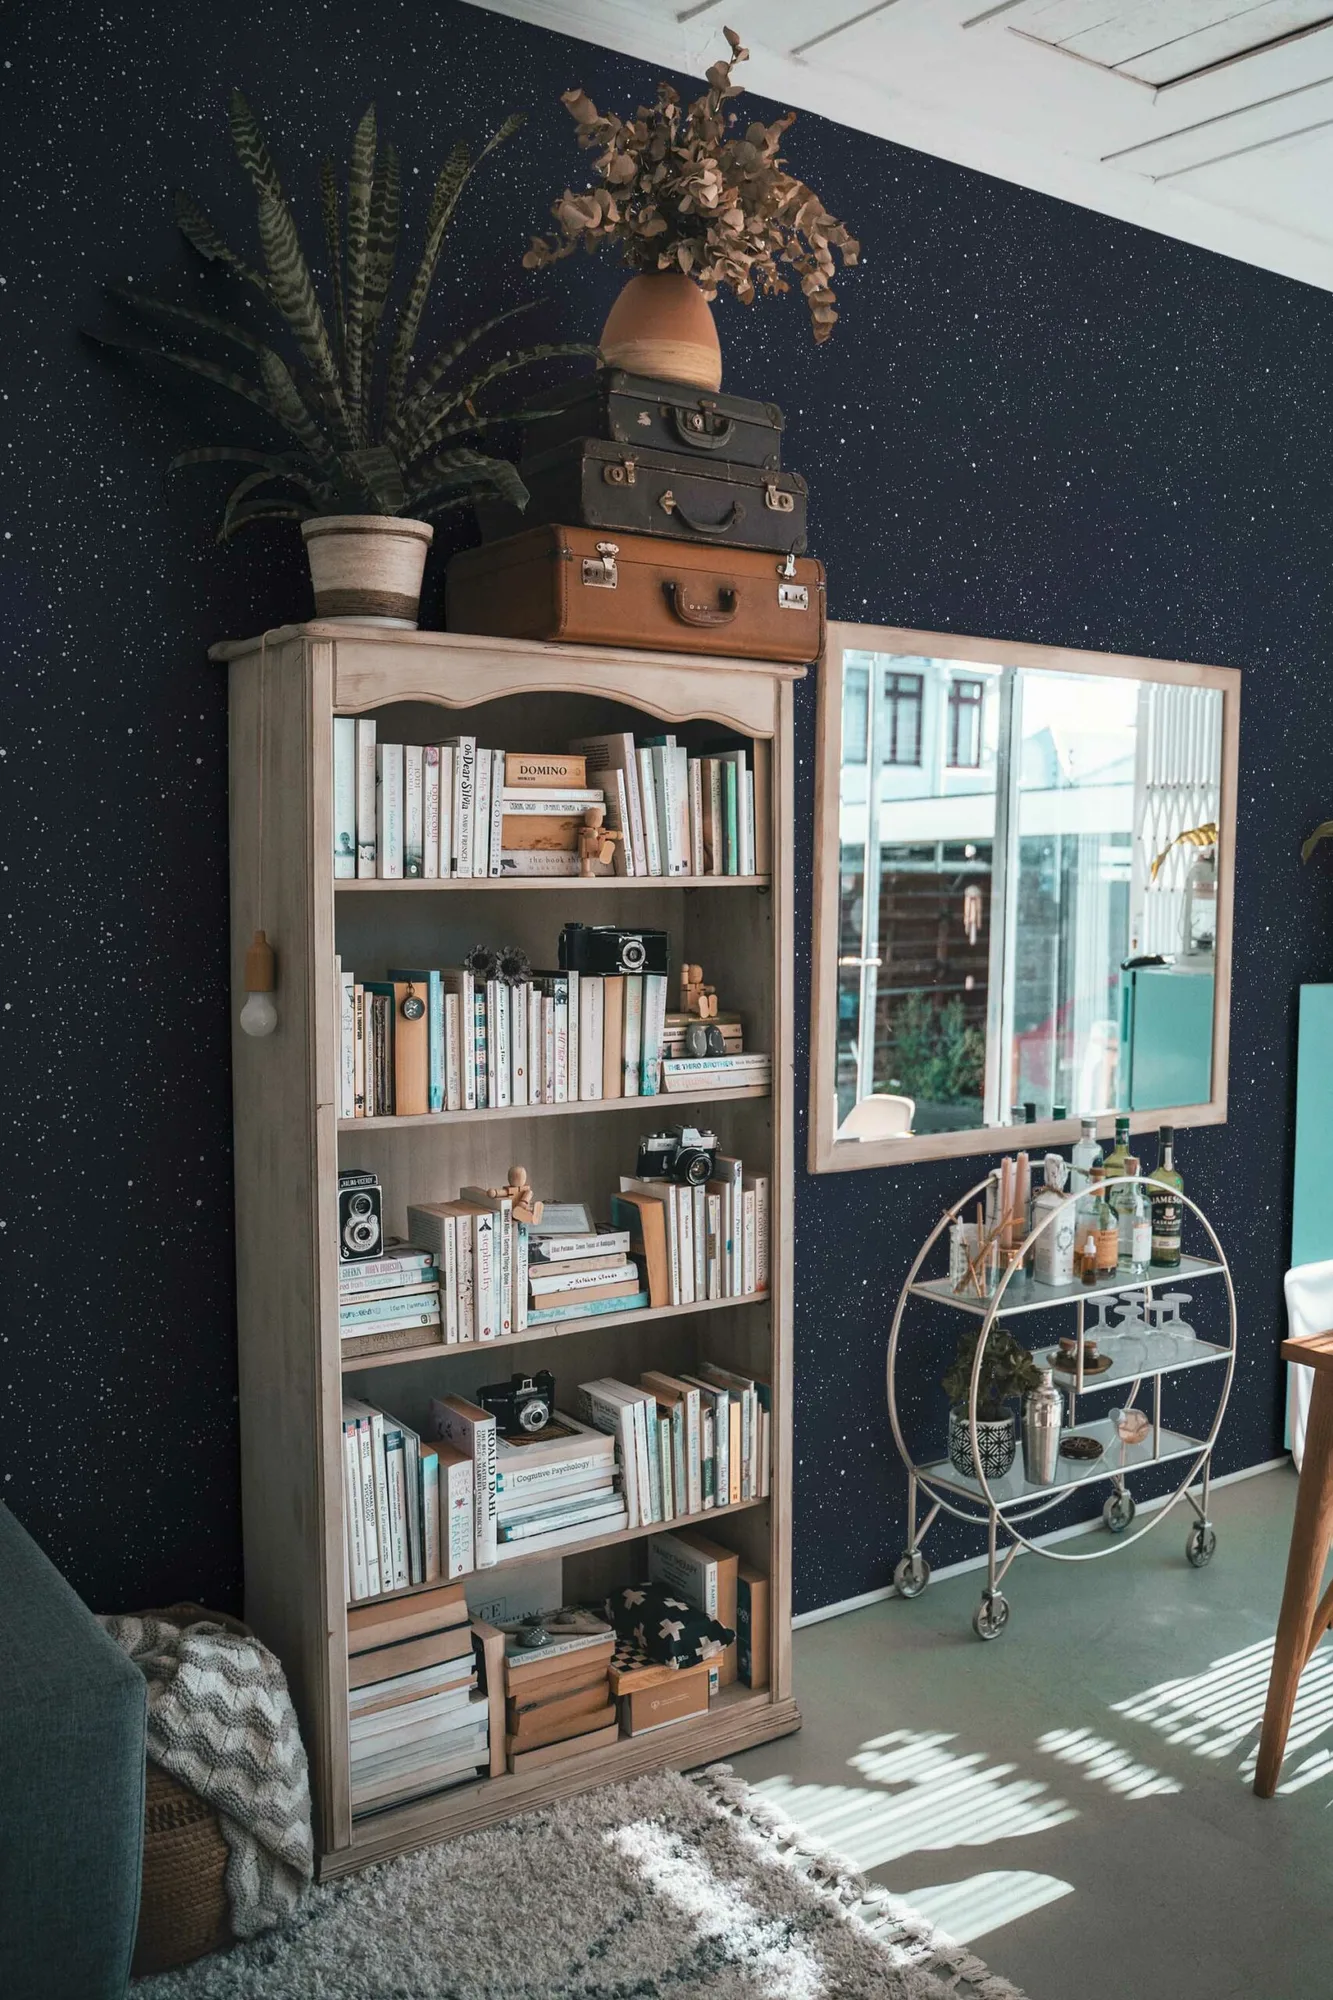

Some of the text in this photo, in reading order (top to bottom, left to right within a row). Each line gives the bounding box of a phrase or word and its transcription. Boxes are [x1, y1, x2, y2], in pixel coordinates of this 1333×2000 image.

[461, 743, 474, 810] Oh Dear Silvia
[520, 765, 567, 776] DOMINO
[493, 799, 501, 828] GOD
[681, 1063, 702, 1071] THIRD
[703, 1061, 734, 1070] BROTHER
[502, 1238, 510, 1256] Getting
[479, 1233, 492, 1292] stephen fry
[502, 1256, 510, 1273] Things
[360, 1332, 406, 1345] SJ WATSON
[488, 1428, 496, 1520] ROALD DAHL
[516, 1460, 590, 1483] Cognitive Psychology
[718, 1479, 727, 1493] Gift
[380, 1512, 388, 1544] Variations
[451, 1515, 461, 1560] PEARSE
[461, 1515, 469, 1553] LESLEY
[543, 1647, 556, 1657] Mind
